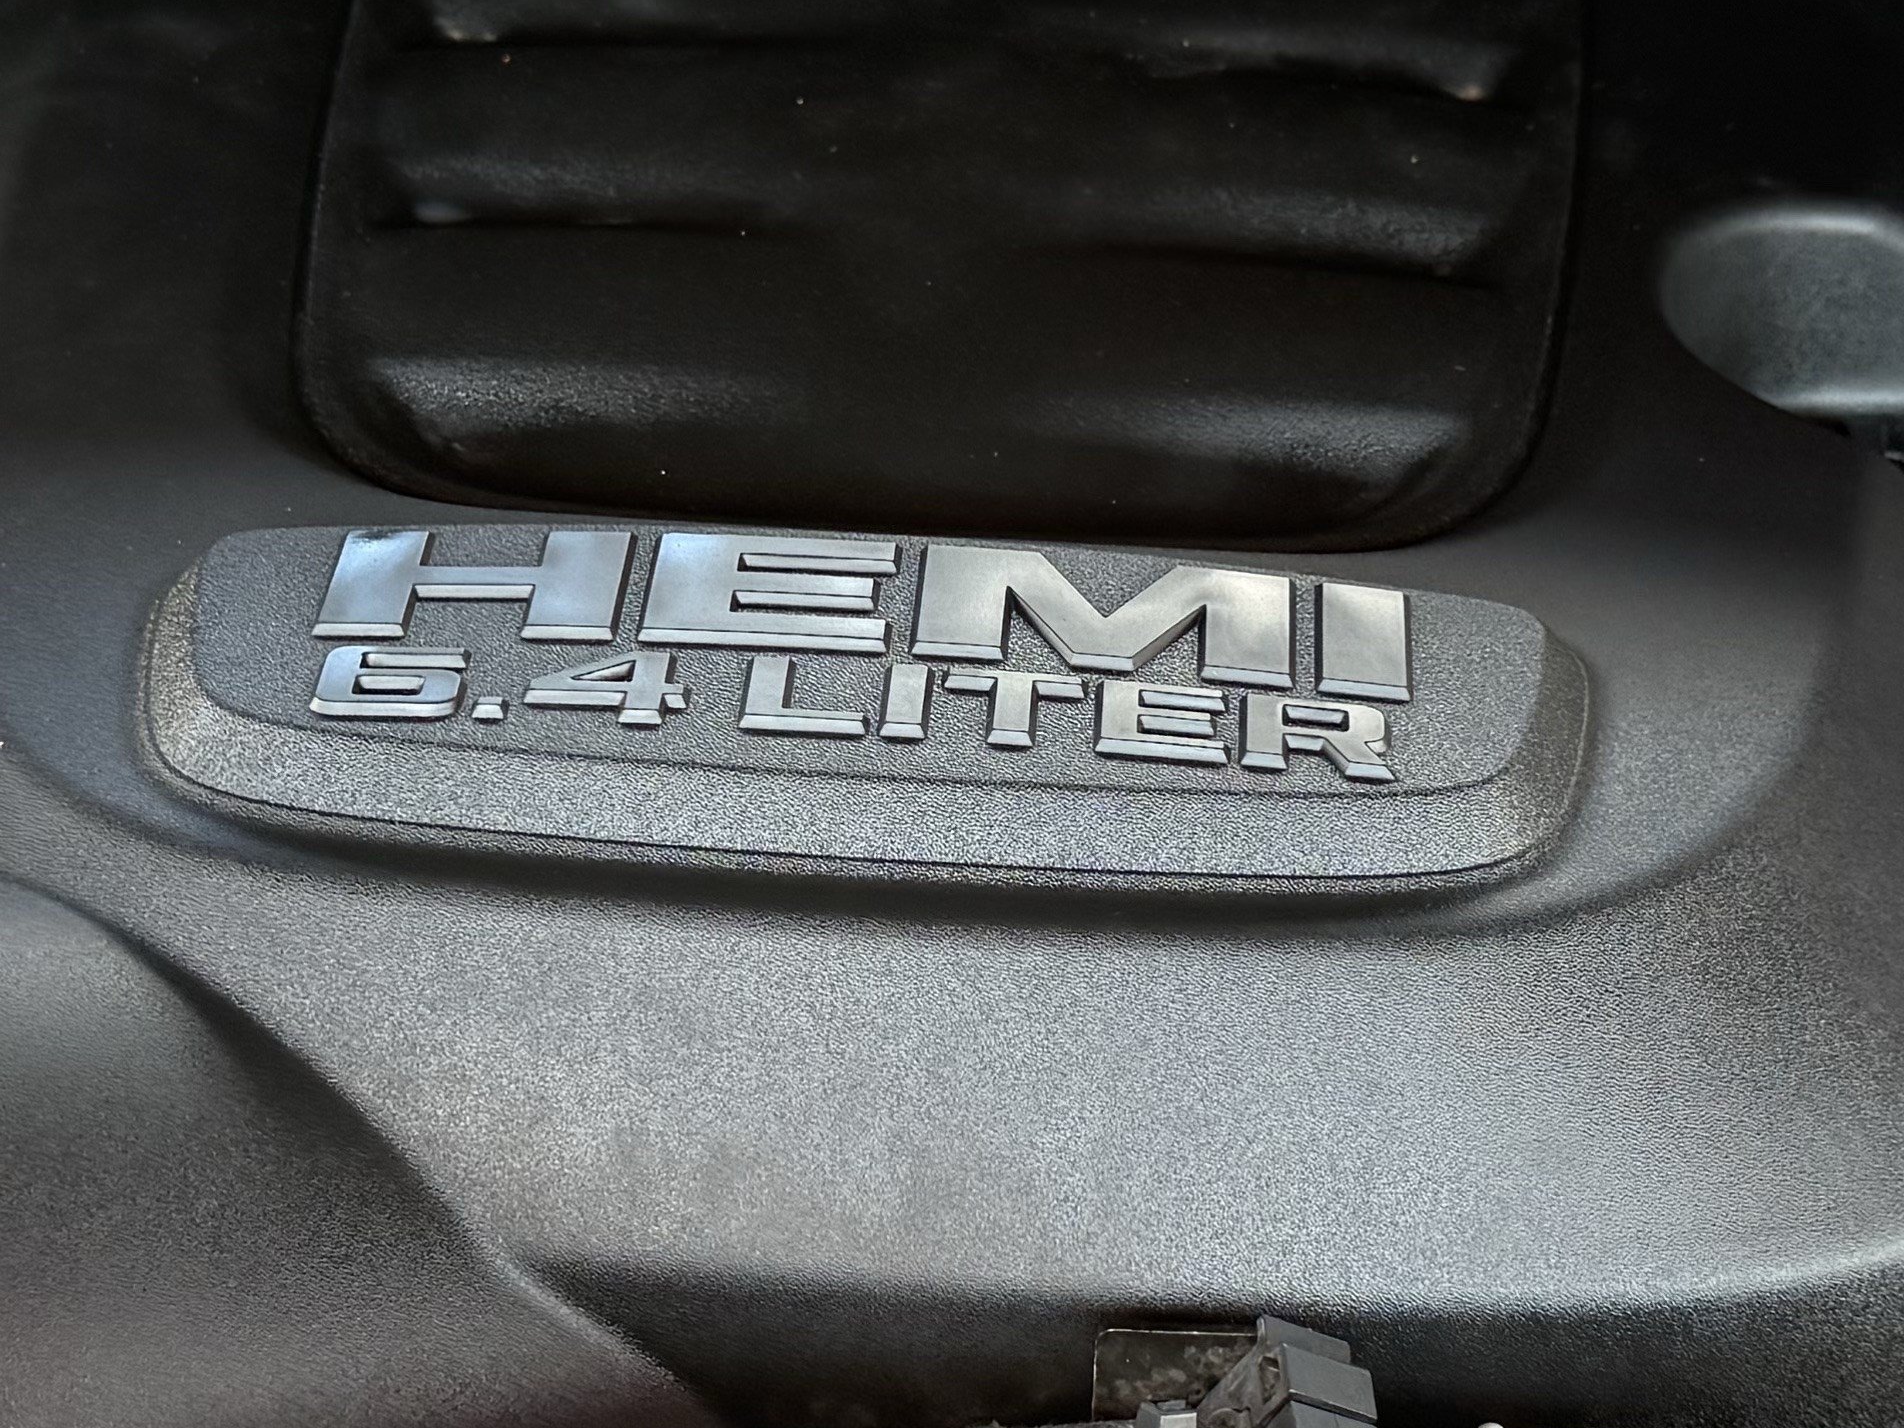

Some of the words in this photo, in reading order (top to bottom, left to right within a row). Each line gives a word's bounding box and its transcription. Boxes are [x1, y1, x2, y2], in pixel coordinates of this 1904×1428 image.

[311, 528, 1413, 703] HEMI
[309, 644, 693, 727] 6.4
[737, 656, 1400, 784] LITER
